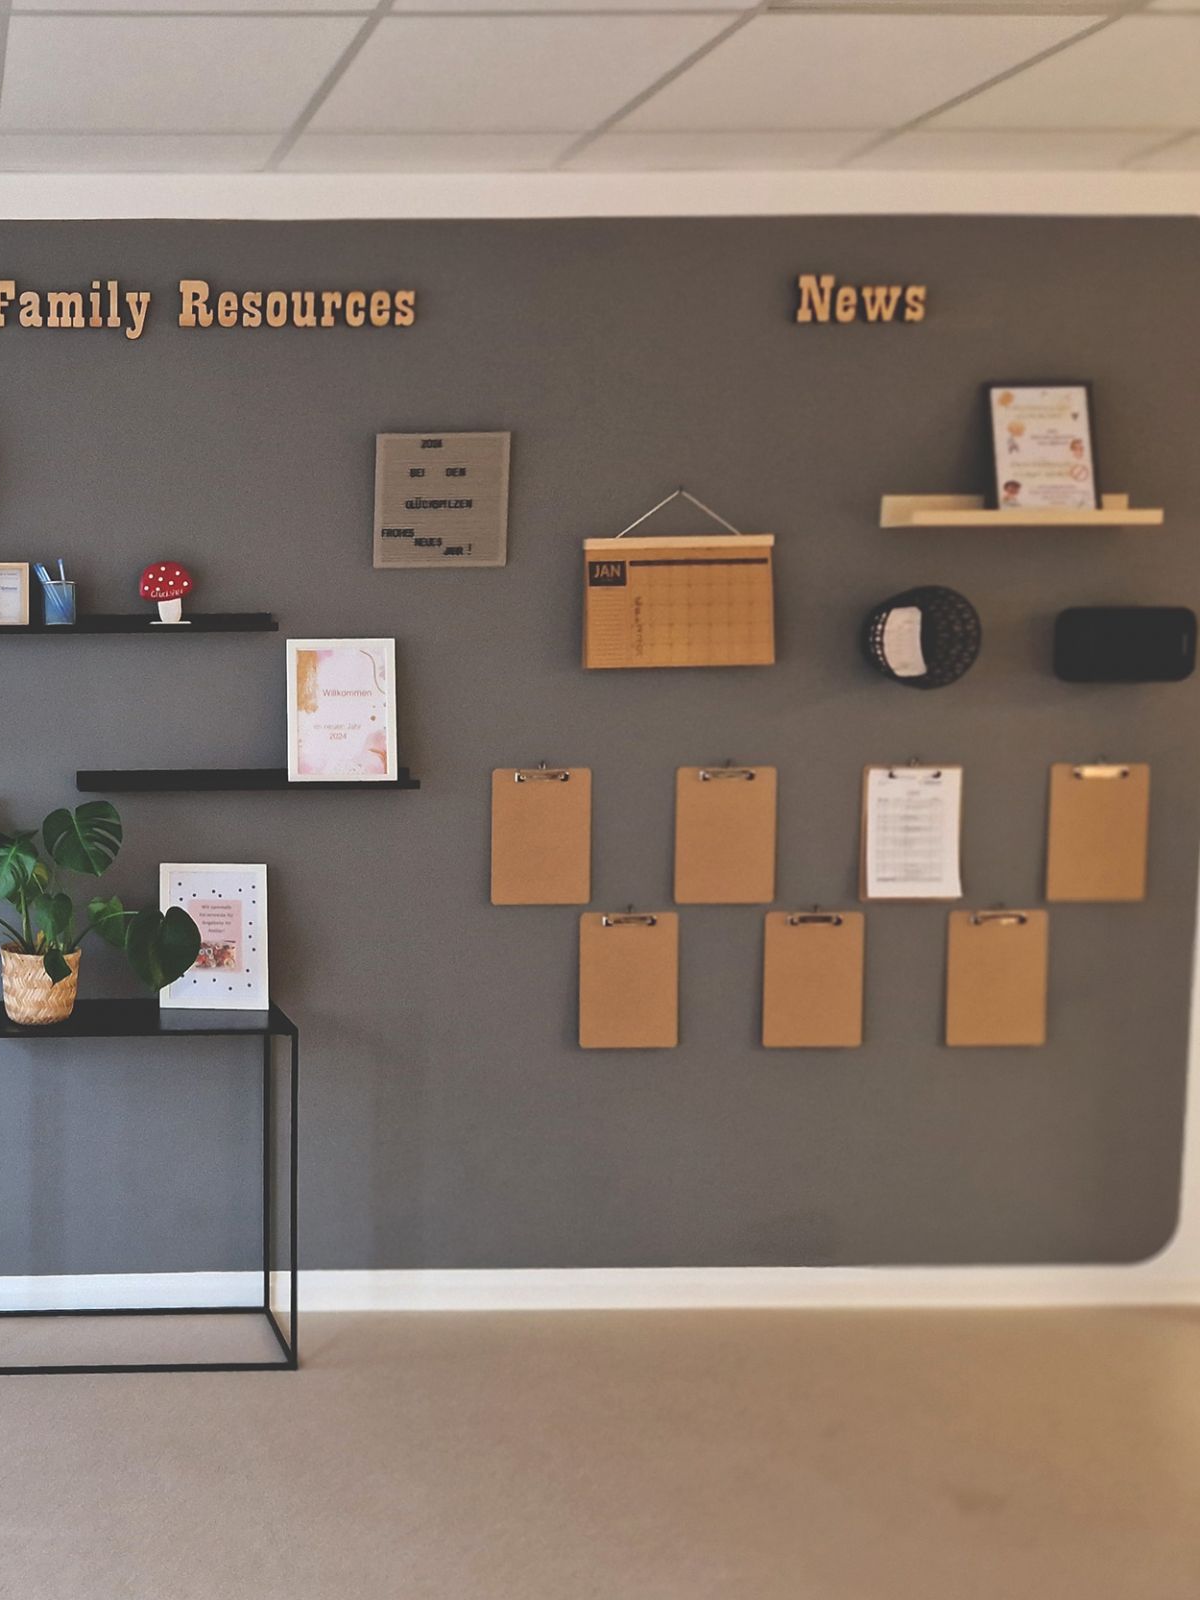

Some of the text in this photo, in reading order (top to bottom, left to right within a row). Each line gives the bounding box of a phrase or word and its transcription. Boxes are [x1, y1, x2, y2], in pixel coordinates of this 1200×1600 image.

[178, 278, 416, 328] Resources
[796, 274, 926, 322] News
[594, 564, 621, 578] JAN
[322, 689, 372, 697] Willkommen
